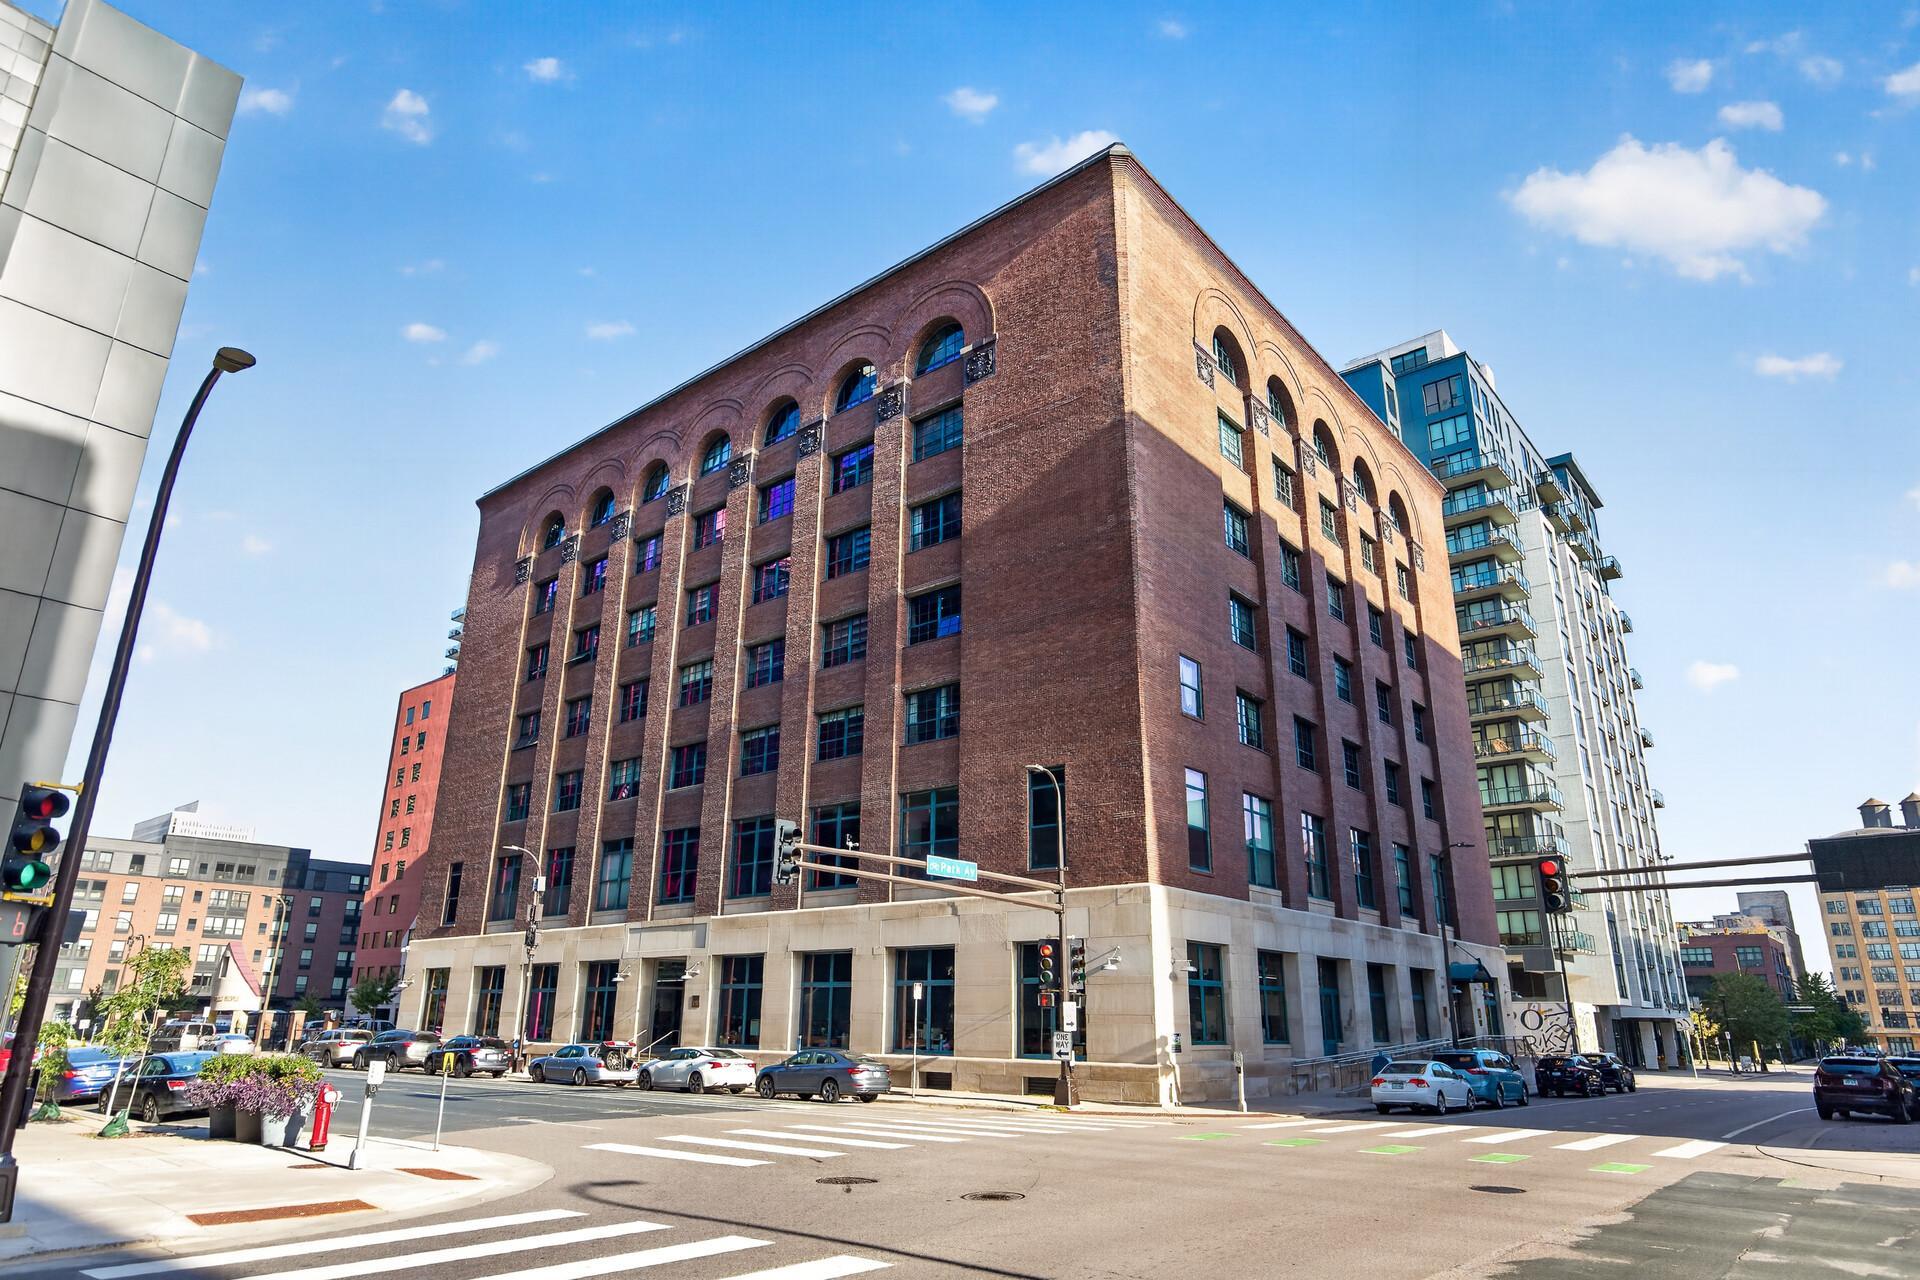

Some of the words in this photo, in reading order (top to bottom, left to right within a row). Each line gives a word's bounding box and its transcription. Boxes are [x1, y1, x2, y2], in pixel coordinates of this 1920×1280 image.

[940, 862, 961, 875] Park
[1056, 1033, 1069, 1041] ONE
[1055, 1041, 1070, 1049] WAY
